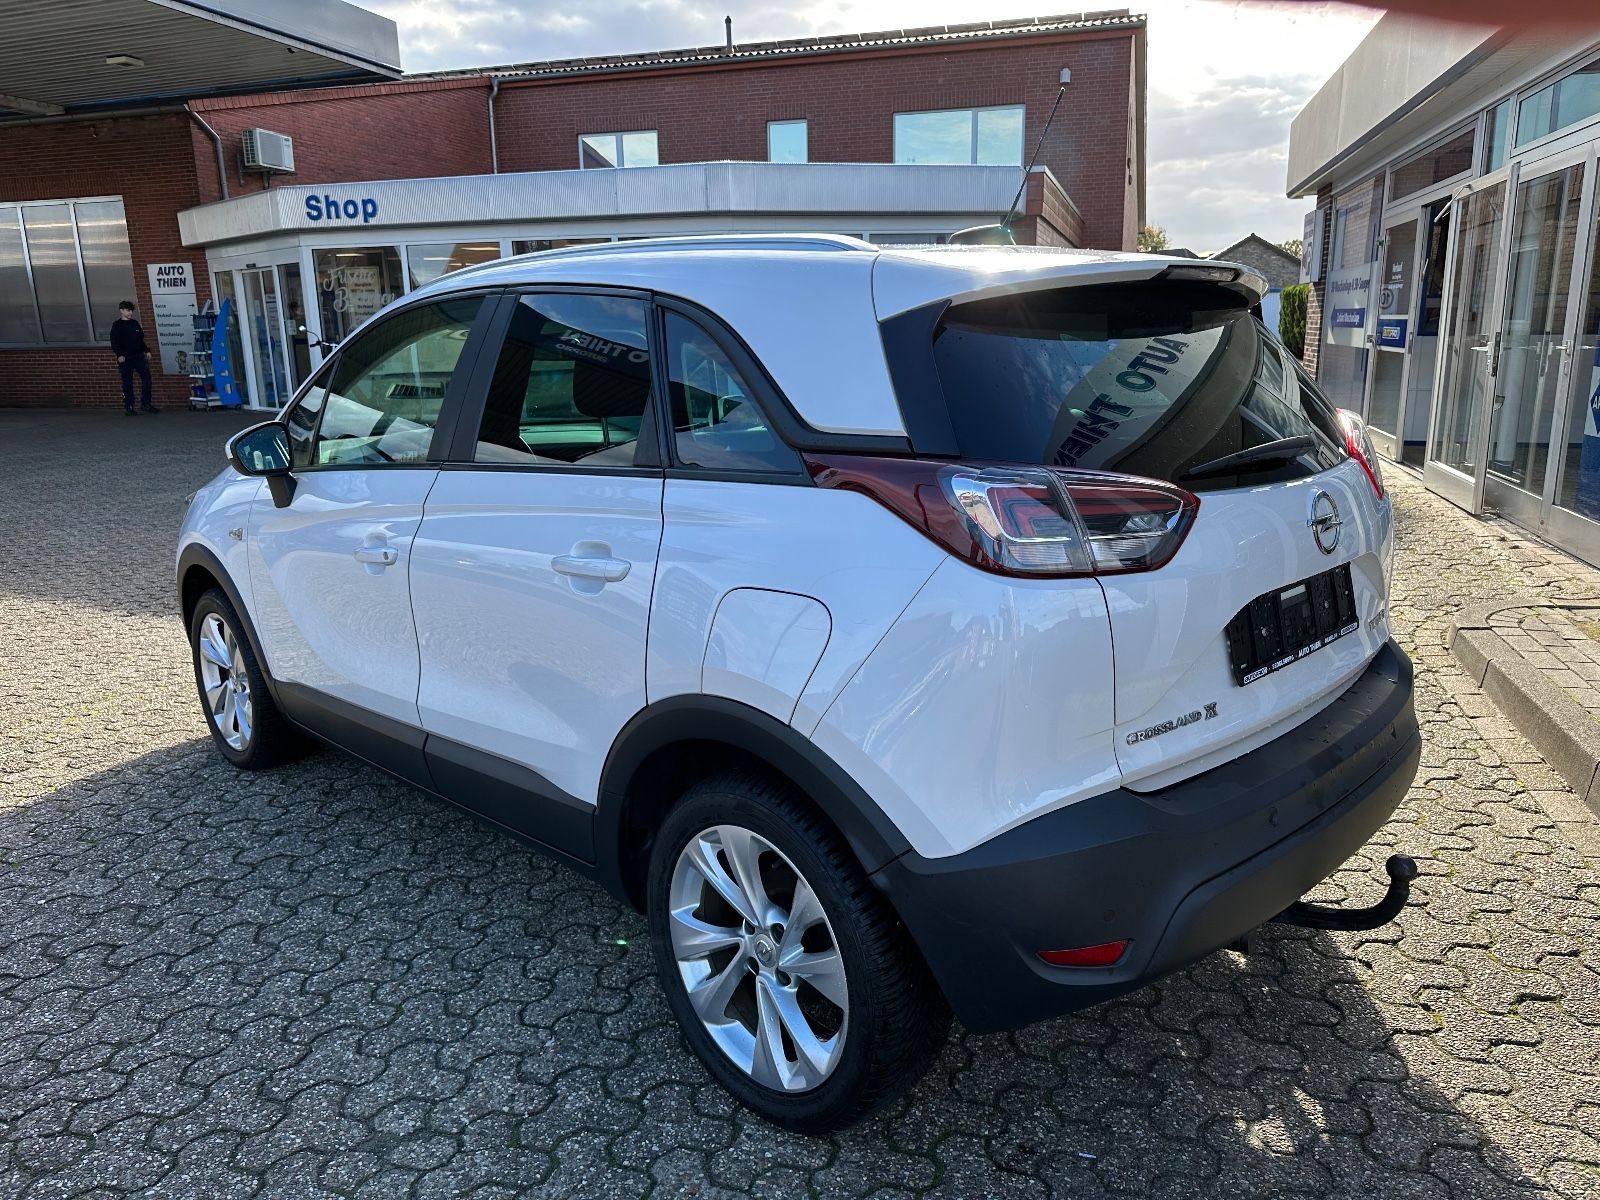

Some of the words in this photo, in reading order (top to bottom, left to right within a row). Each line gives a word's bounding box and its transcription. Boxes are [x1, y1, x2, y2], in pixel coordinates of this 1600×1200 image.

[305, 194, 377, 223] Shop
[157, 265, 184, 276] AUTO
[157, 277, 187, 288] THIEN
[1298, 645, 1309, 657] AUTO
[1126, 710, 1202, 745] CROSSLAND
[1203, 702, 1218, 720] X
